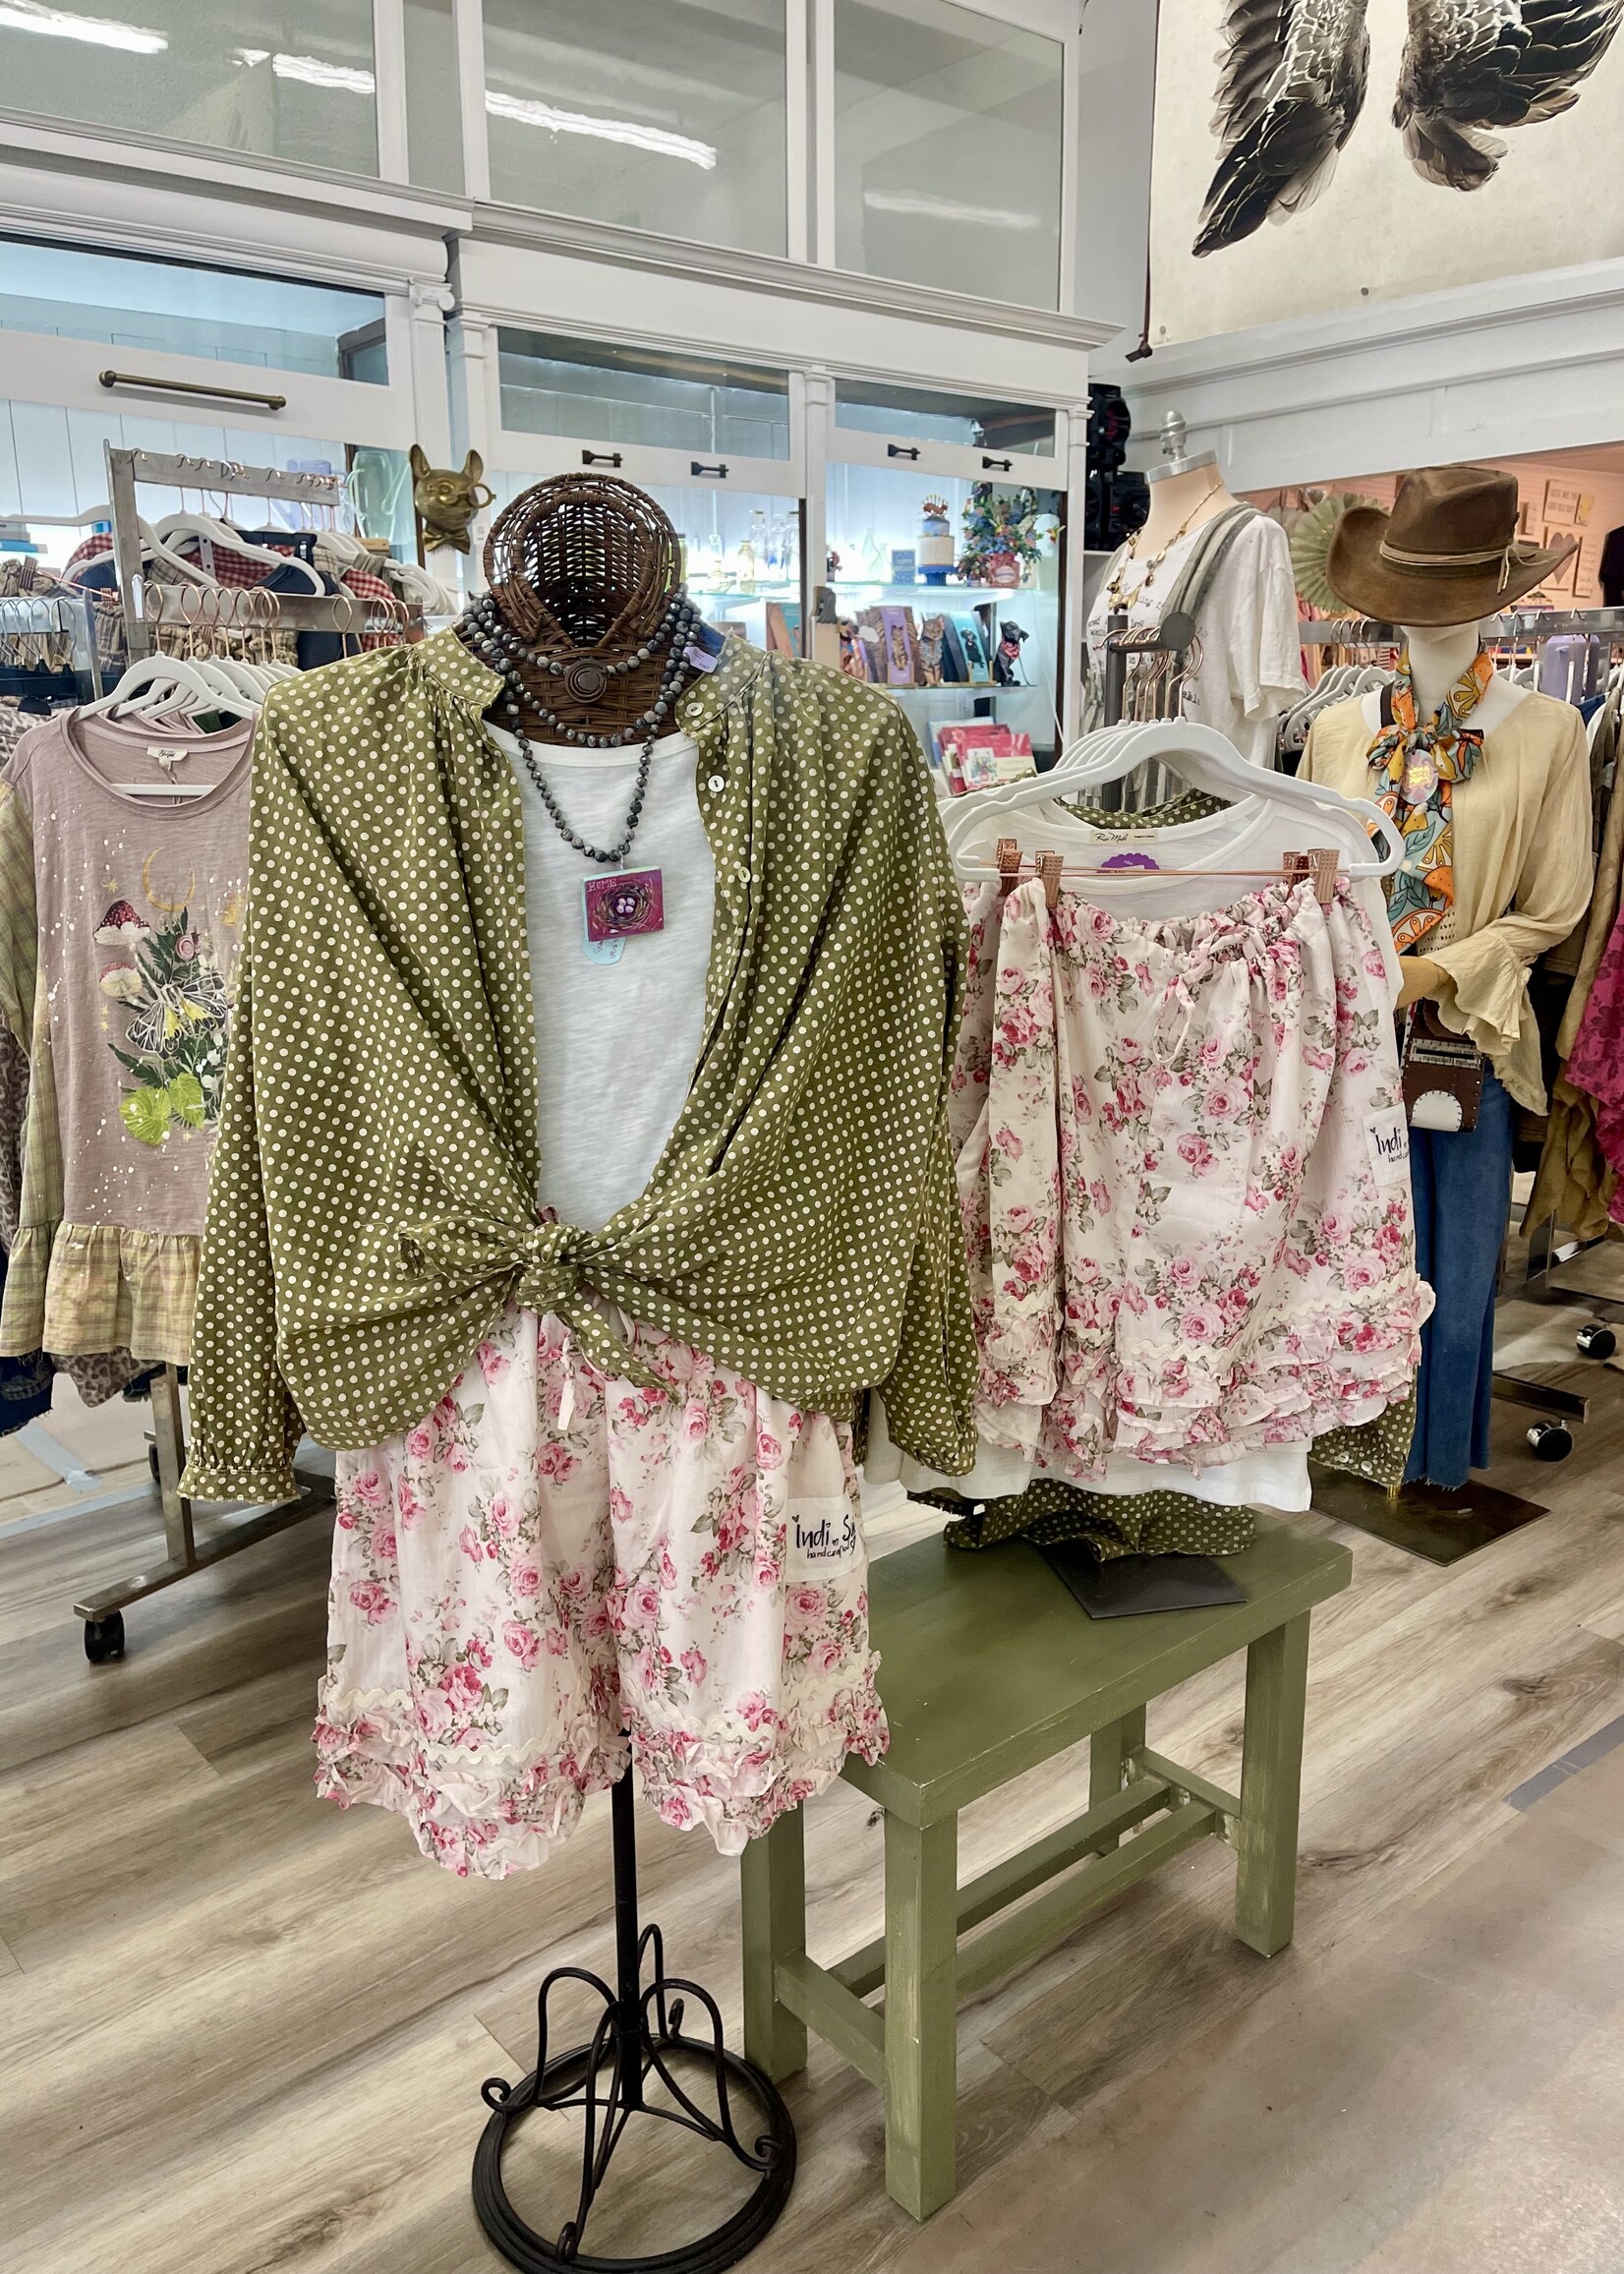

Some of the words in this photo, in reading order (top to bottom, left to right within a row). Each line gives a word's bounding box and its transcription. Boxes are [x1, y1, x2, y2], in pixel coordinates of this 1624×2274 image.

[588, 879, 617, 892] HOME
[1370, 1127, 1402, 1155] Indi
[792, 1515, 832, 1548] Indi
